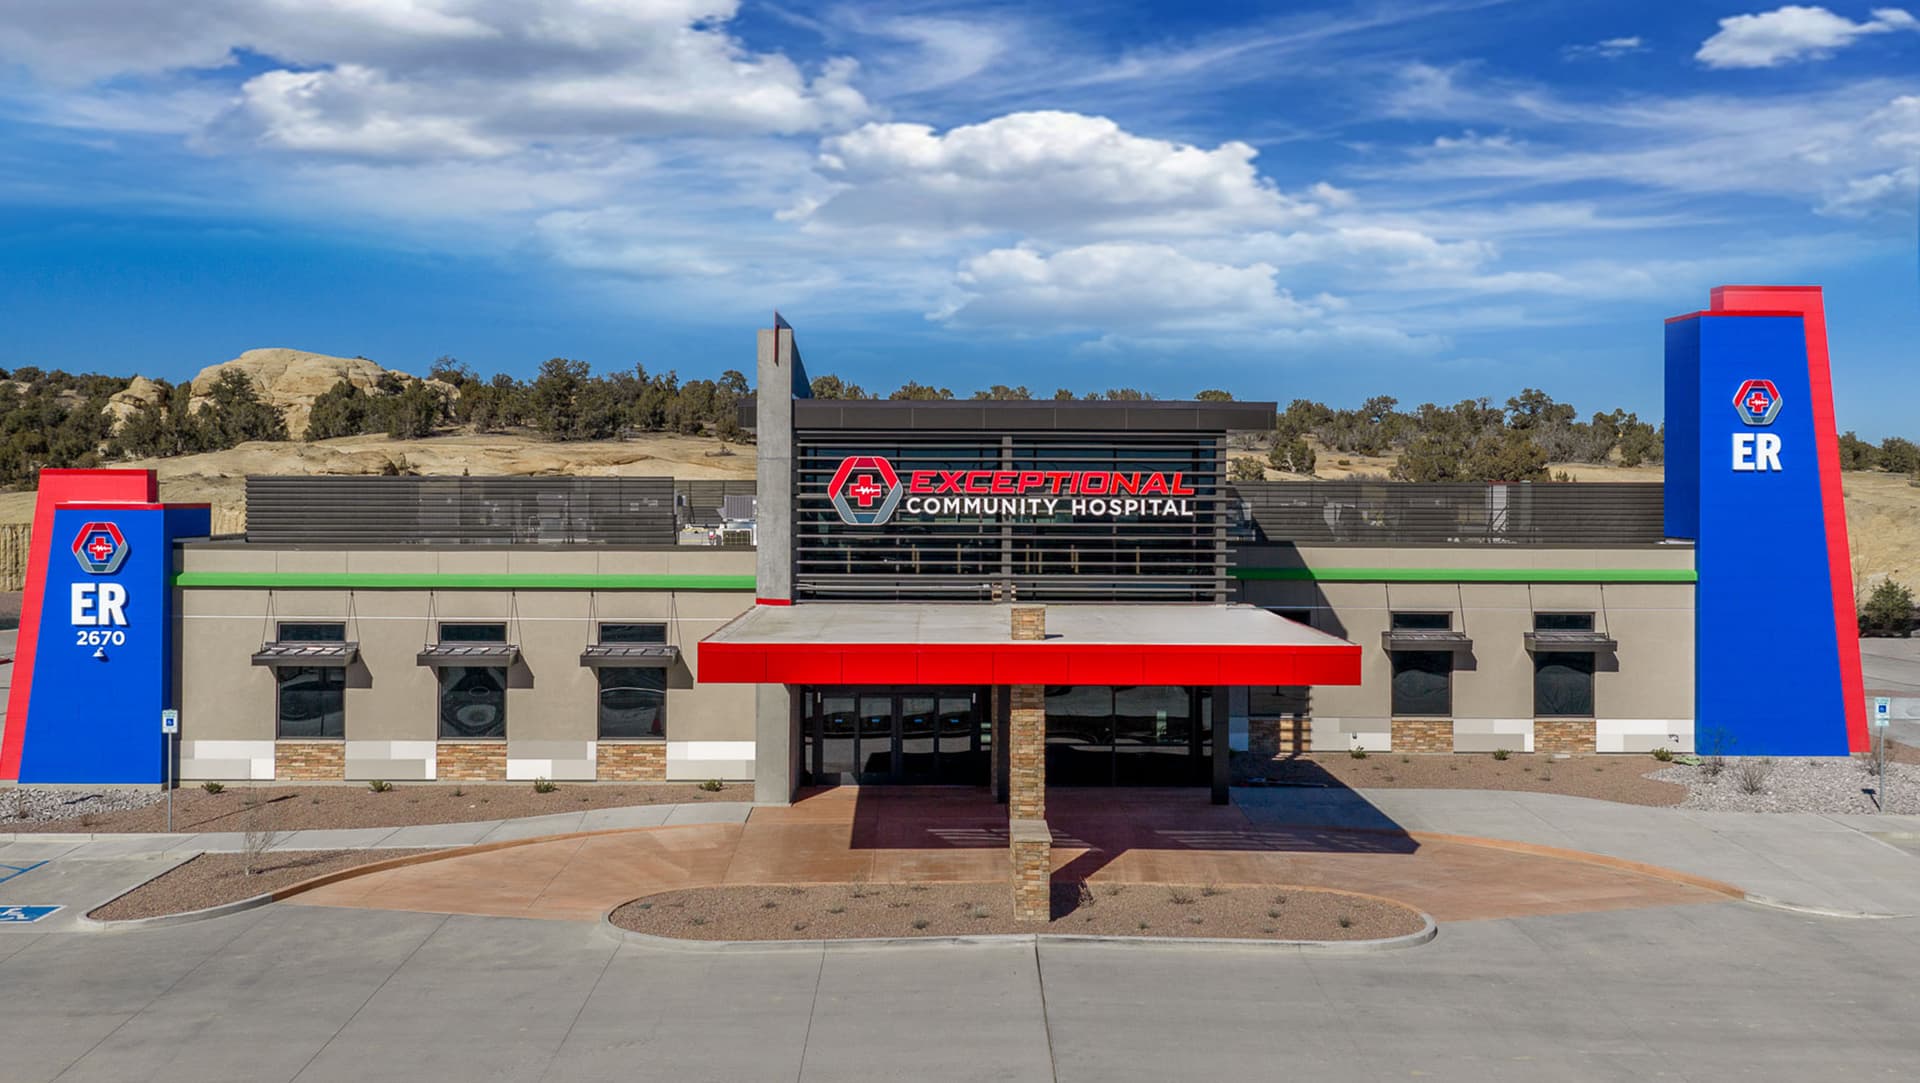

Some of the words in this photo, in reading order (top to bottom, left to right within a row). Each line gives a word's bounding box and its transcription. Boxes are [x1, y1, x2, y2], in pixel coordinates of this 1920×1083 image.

[1732, 433, 1782, 470] ER
[909, 470, 1195, 495] EXCEPTIONAL
[906, 498, 1058, 515] COMMUNITY
[1071, 499, 1194, 516] HOSPITAL
[71, 583, 127, 625] ER
[76, 630, 126, 646] 2670
